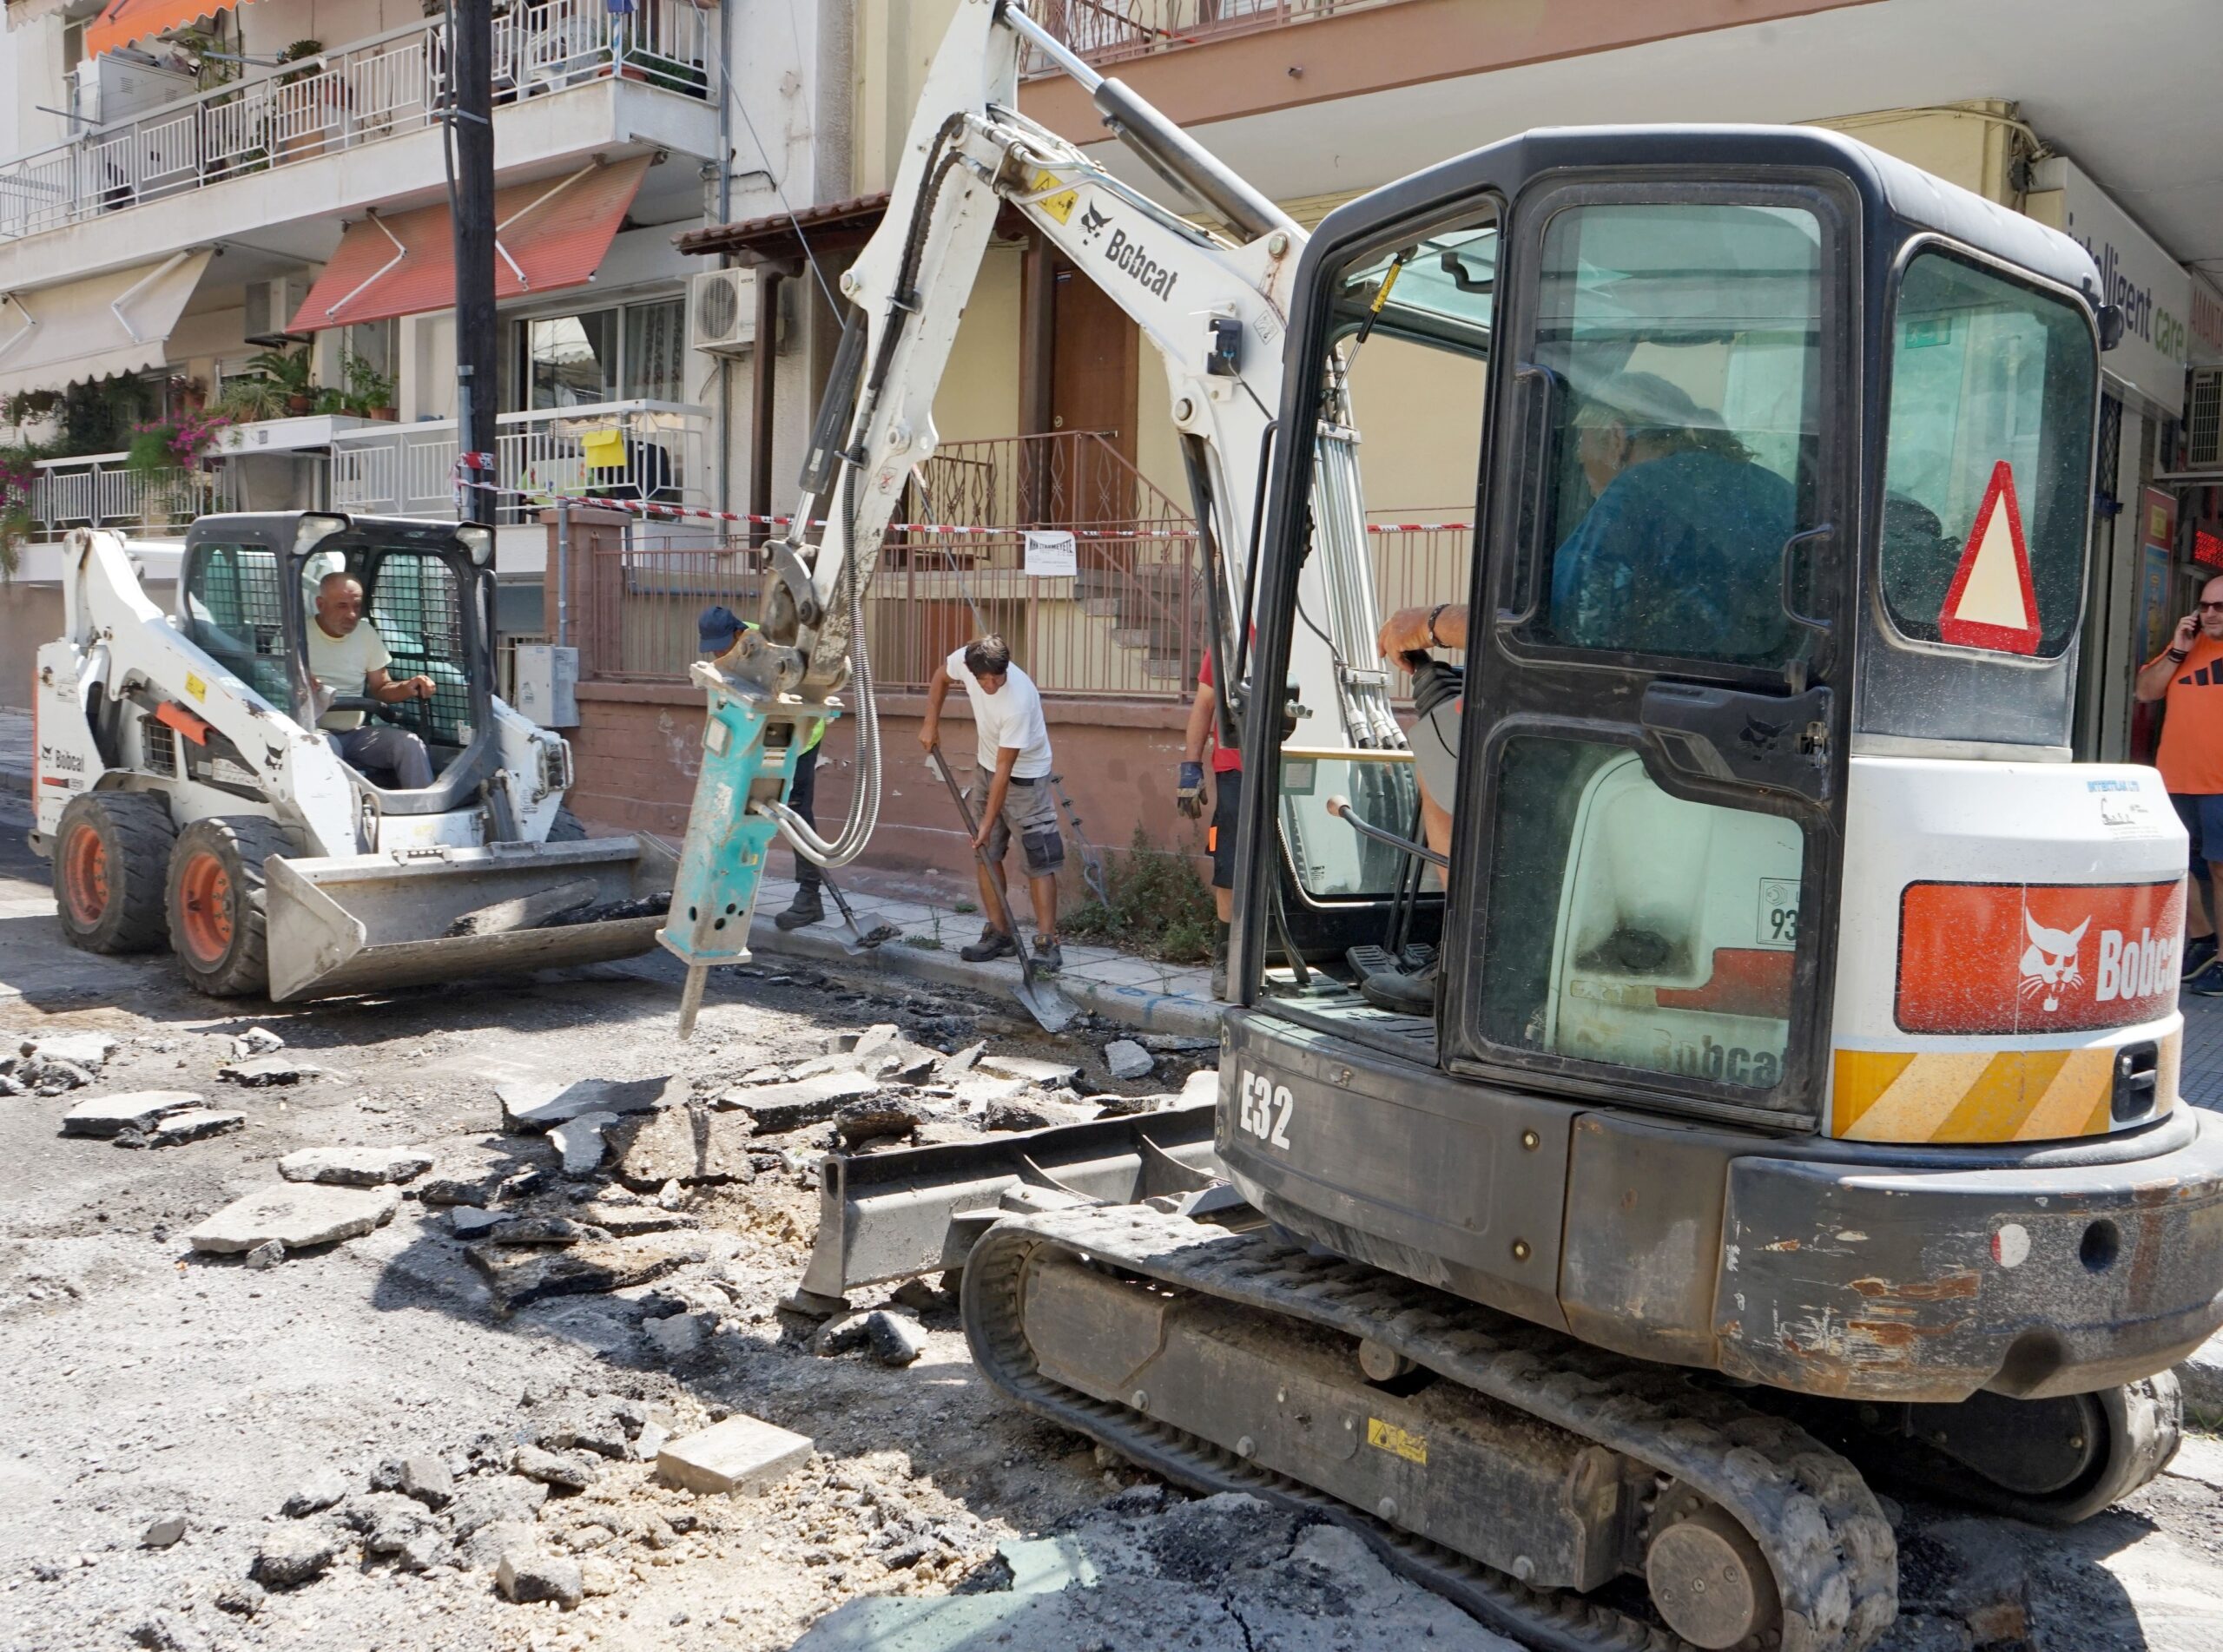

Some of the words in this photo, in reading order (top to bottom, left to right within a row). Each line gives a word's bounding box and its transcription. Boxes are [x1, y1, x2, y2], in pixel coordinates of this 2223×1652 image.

[1105, 227, 1178, 302] Bobcat
[2068, 211, 2154, 344] elligent
[2154, 306, 2185, 365] care
[56, 749, 85, 773] Bobcat
[1771, 908, 1799, 941] 93
[2095, 926, 2178, 1002] Bobca
[1652, 1029, 1789, 1087] obca
[1240, 1070, 1294, 1150] E32
